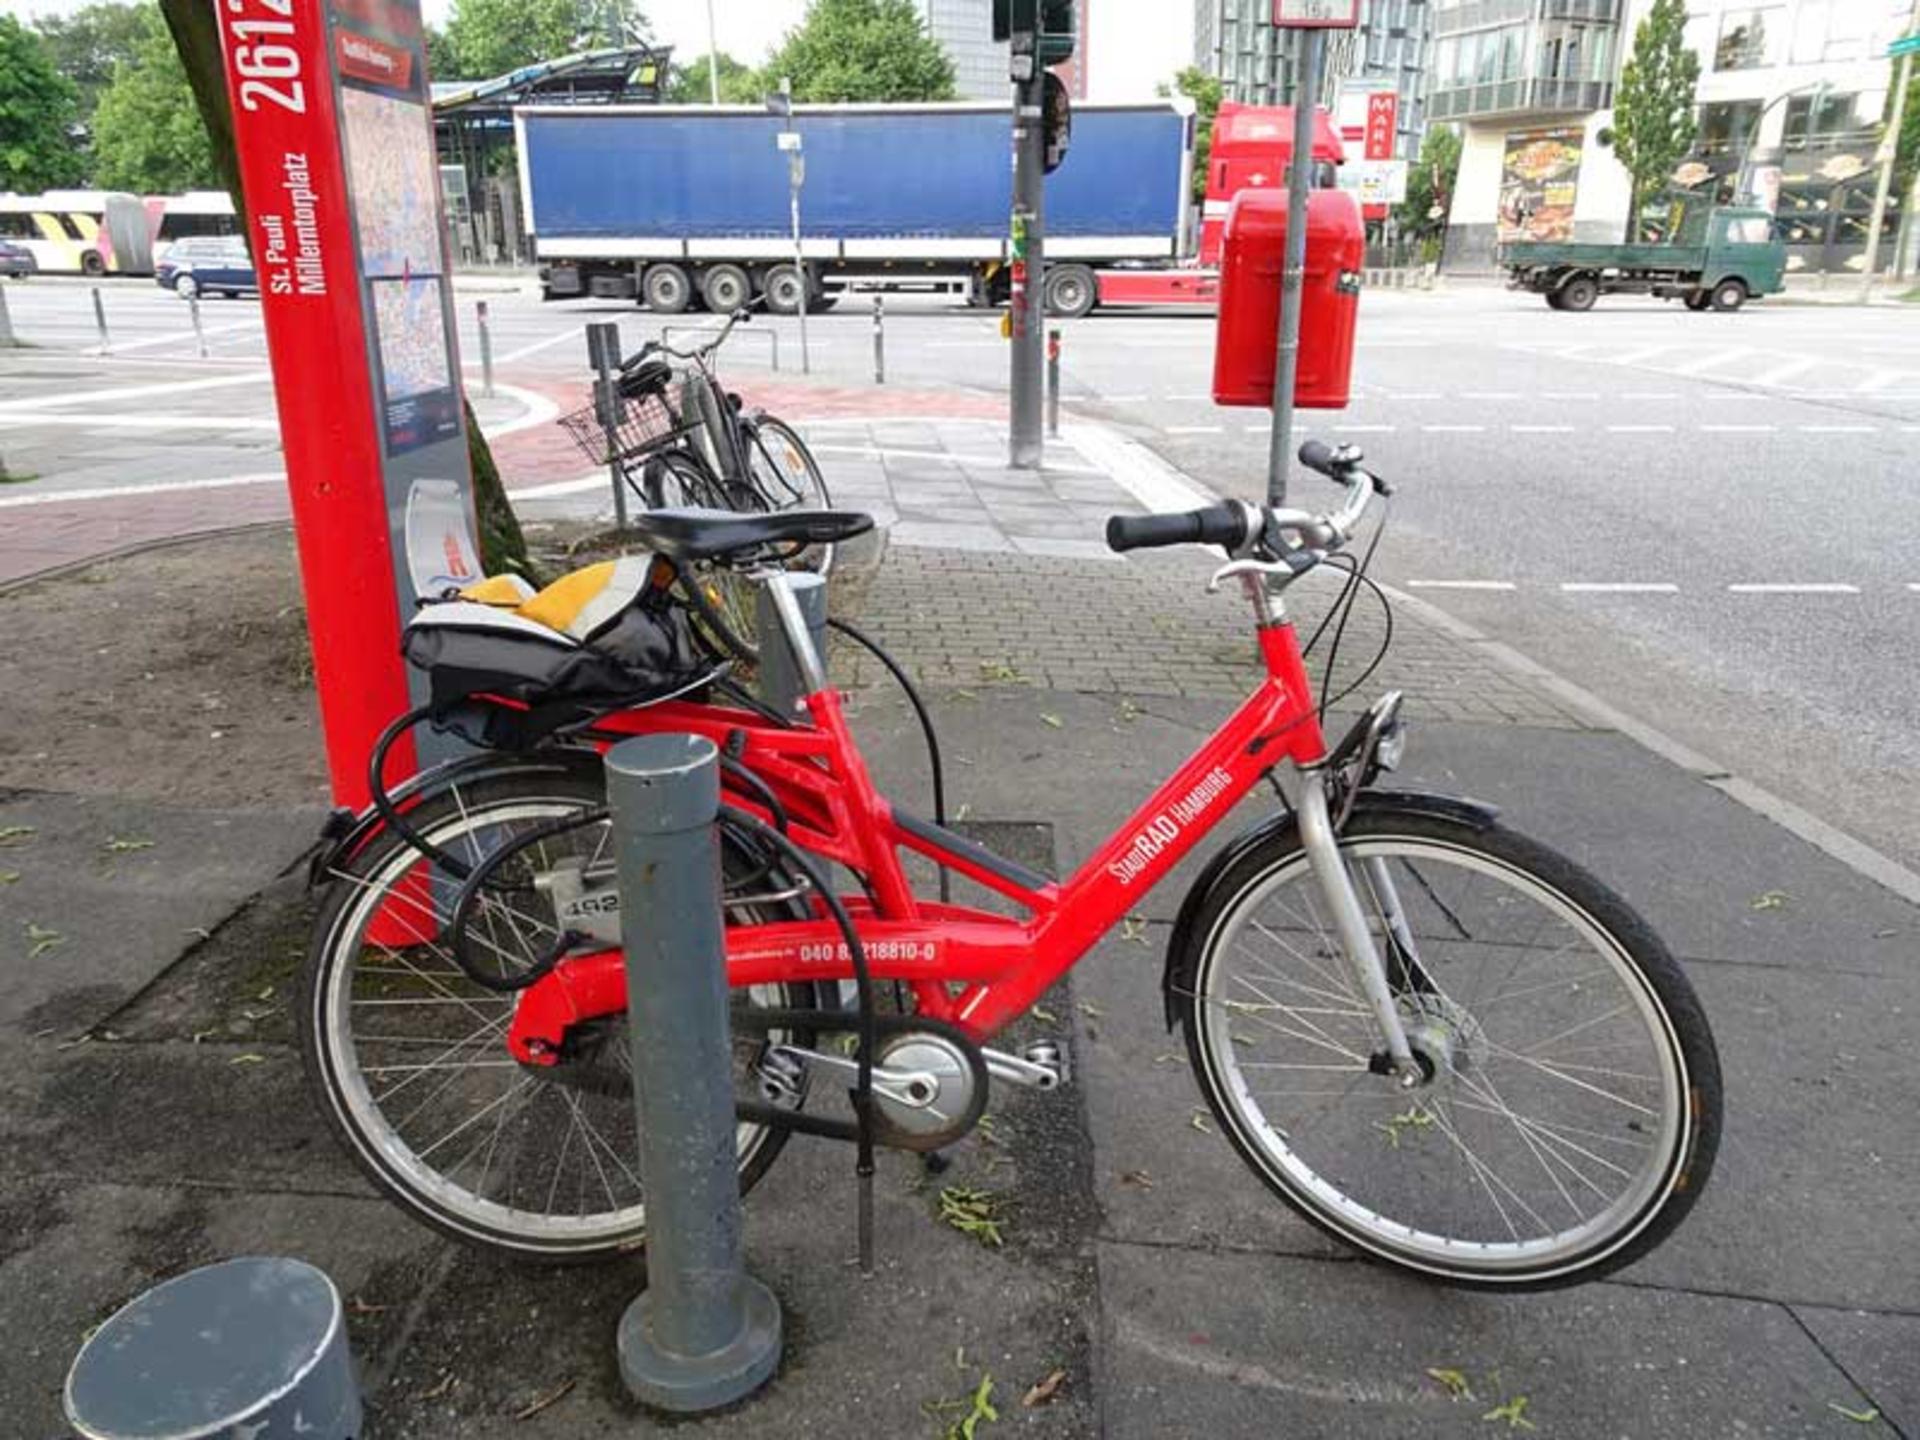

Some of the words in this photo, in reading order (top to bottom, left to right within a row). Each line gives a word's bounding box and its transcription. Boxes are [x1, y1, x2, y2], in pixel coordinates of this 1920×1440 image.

[258, 215, 288, 264] Pauli
[282, 153, 327, 296] Millerntorplatz
[1168, 766, 1232, 826] HAMBURG
[800, 943, 833, 962] 040
